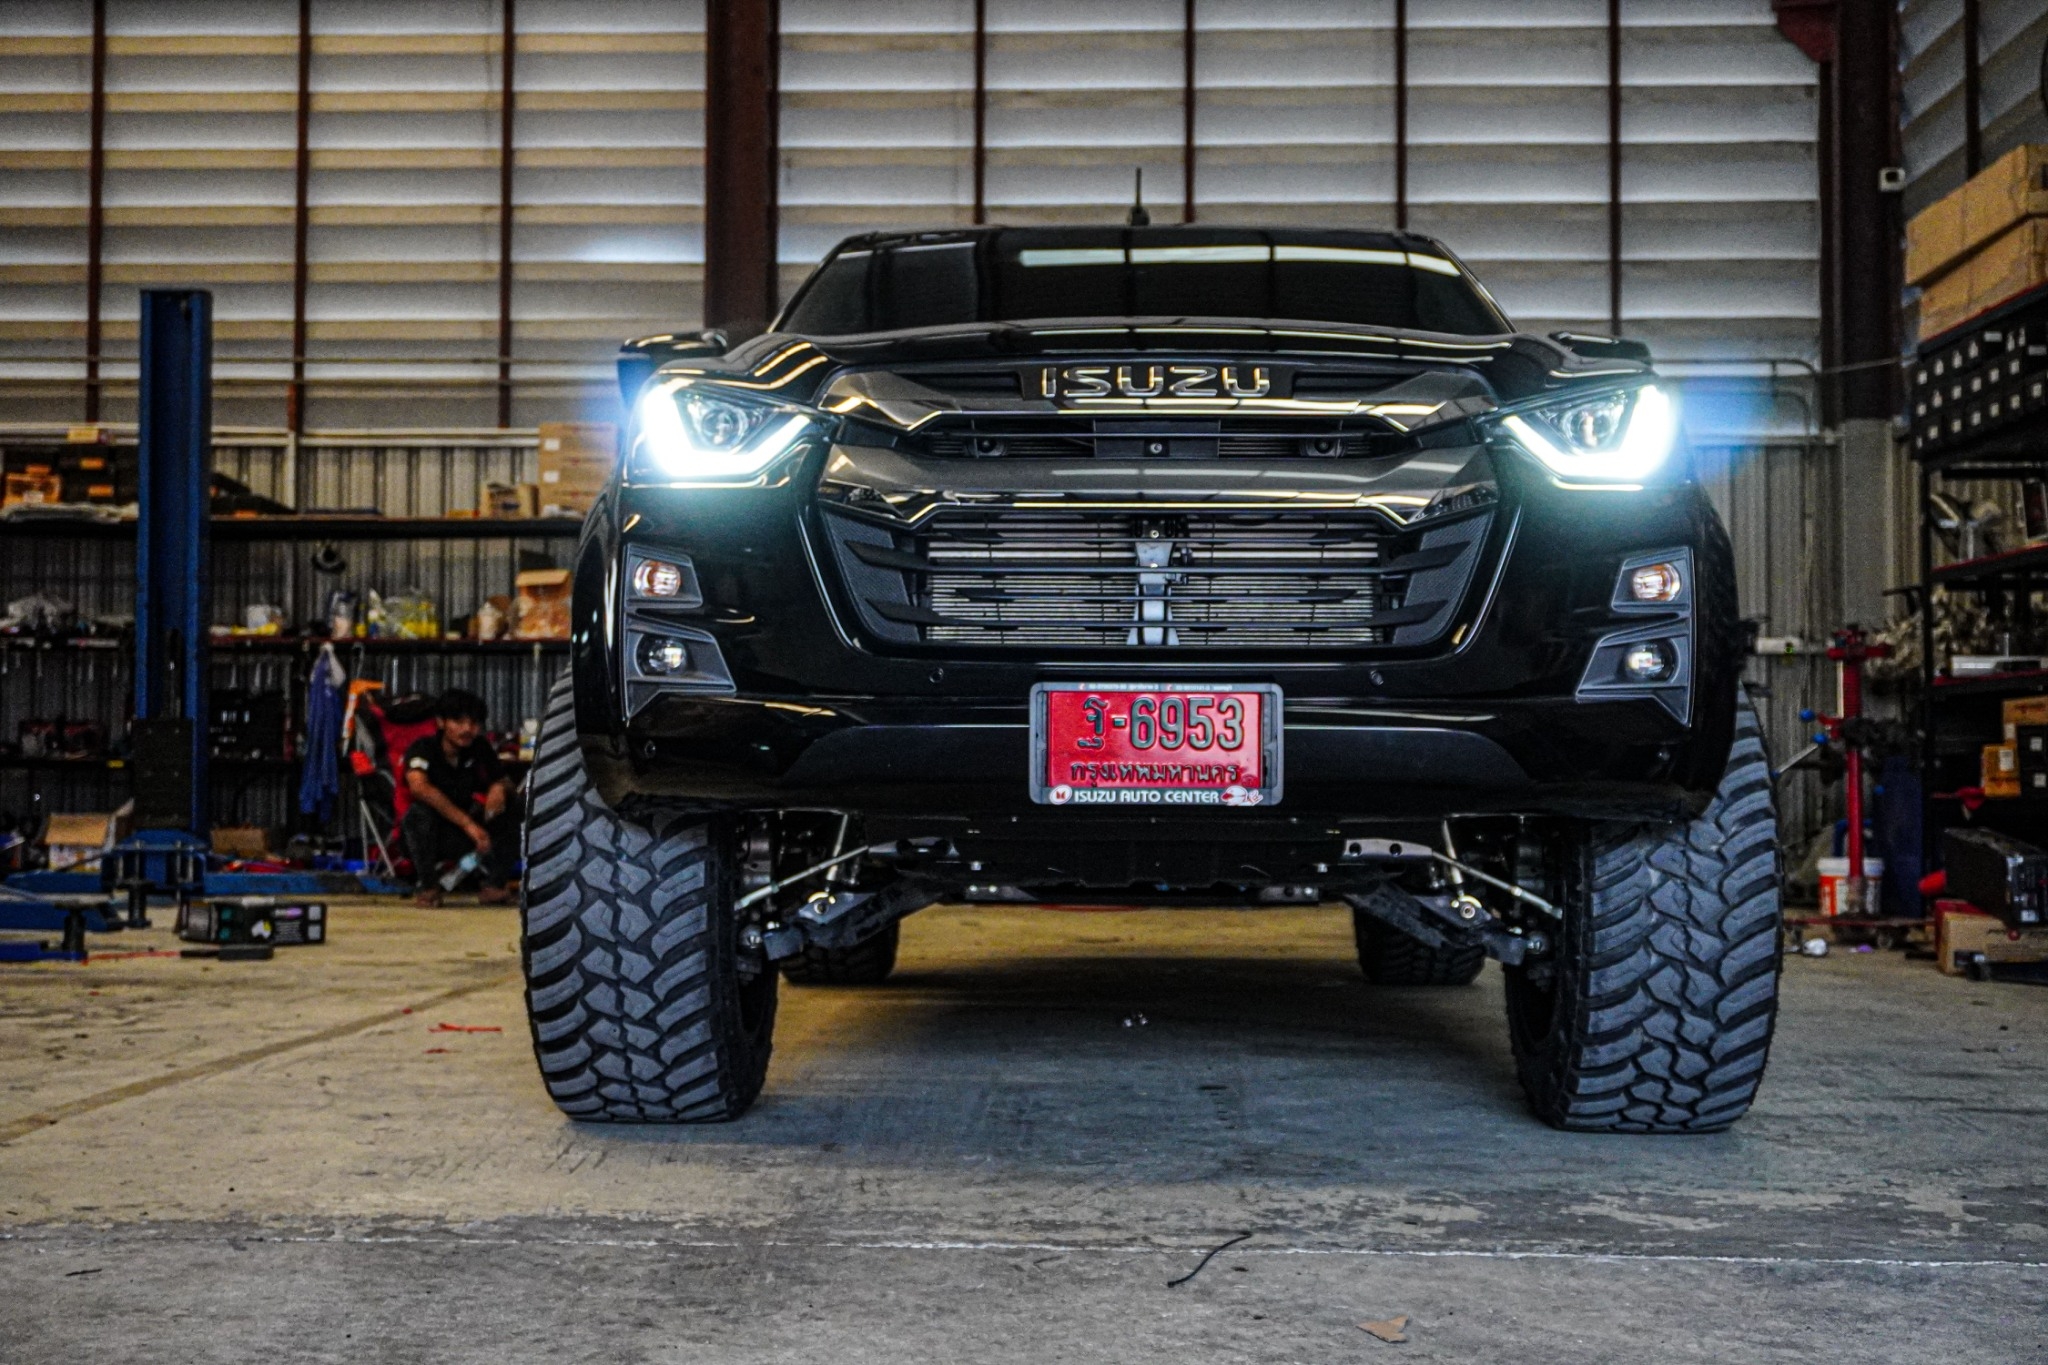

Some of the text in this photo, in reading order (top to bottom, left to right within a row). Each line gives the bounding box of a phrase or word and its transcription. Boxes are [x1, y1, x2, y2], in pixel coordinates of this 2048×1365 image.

[1041, 366, 1270, 398] ISUZU
[1071, 762, 1239, 786] กรุงเทพมหานคร
[1074, 789, 1219, 803] ISUZU AUTO CENTER
